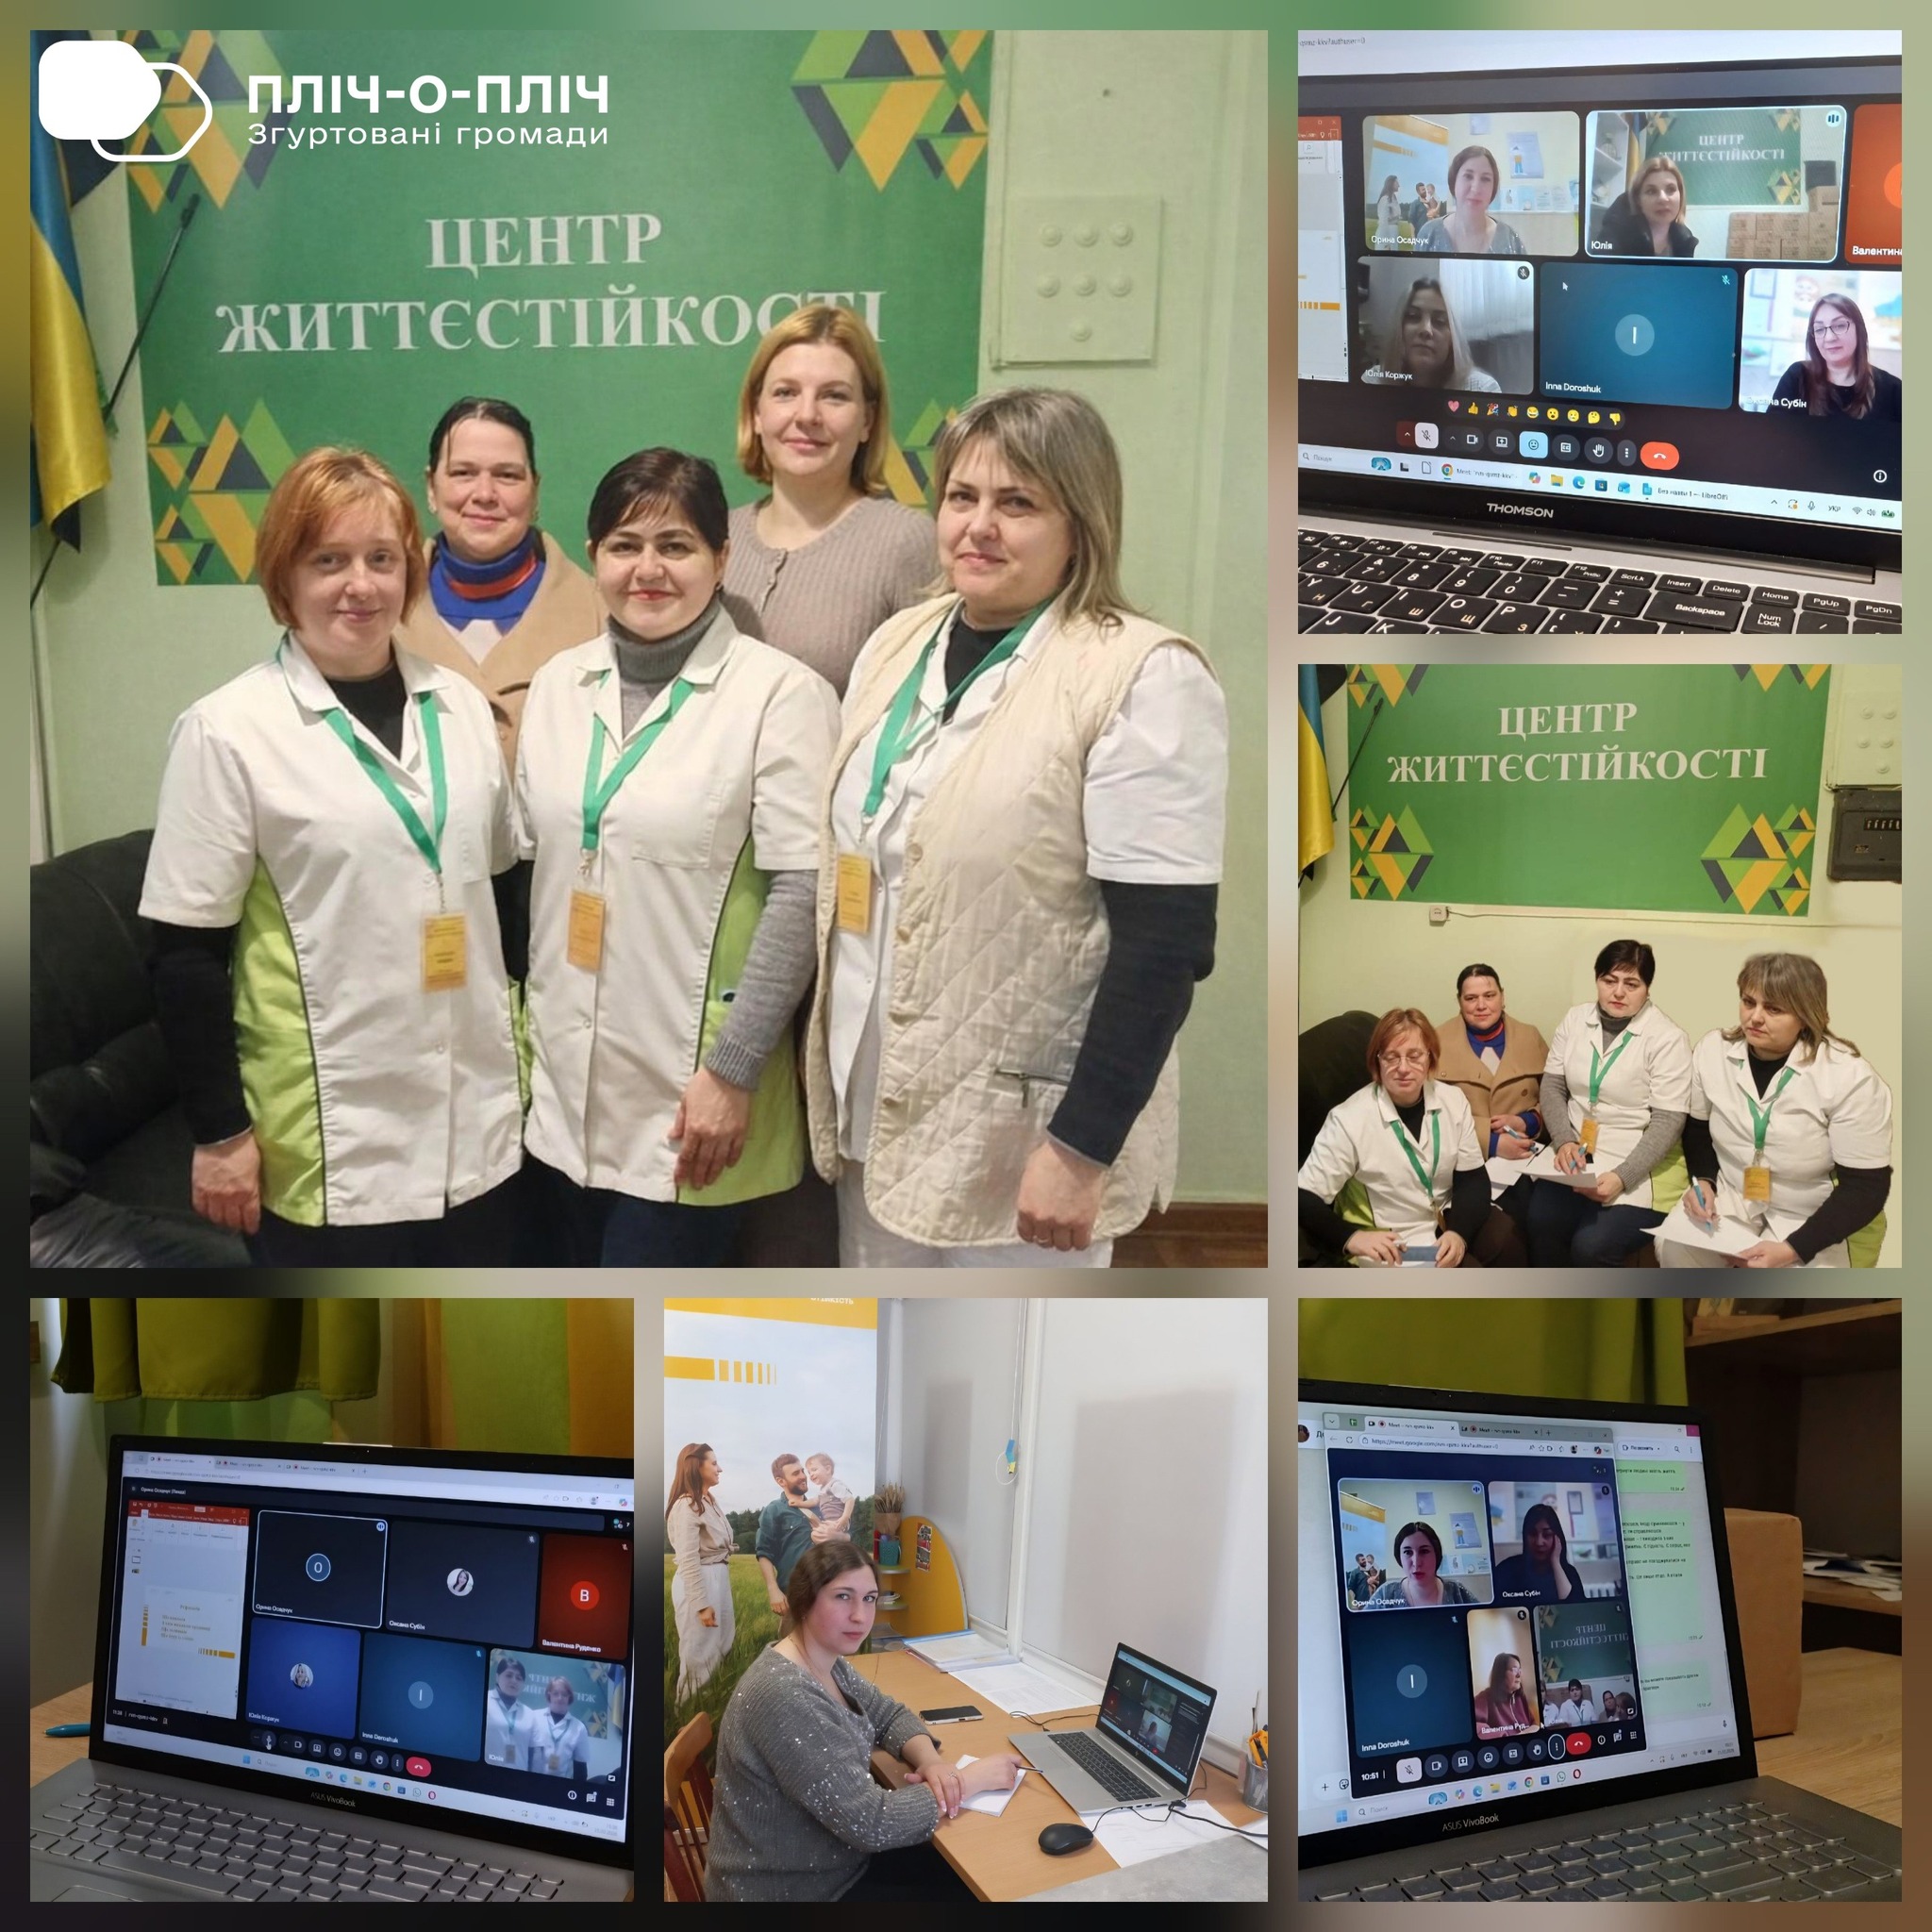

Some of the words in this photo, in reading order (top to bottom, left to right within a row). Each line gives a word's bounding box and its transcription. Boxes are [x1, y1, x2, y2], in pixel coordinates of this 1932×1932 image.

[1698, 134, 1744, 147] ЦЕНТР
[425, 212, 662, 278] ЦЕНТР
[1591, 241, 1613, 250] Юлія
[216, 283, 887, 353] ЖИТТЄСТІЙКОСІ
[1545, 381, 1562, 391] Inna
[1563, 382, 1602, 394] Doroshuk
[1780, 398, 1807, 408] Субін
[1486, 503, 1555, 518] THOMSON
[1307, 578, 1323, 587] Y
[1621, 574, 1644, 582] ScrLk
[1667, 579, 1691, 588] Insert
[1352, 585, 1368, 594] U
[1712, 585, 1740, 594] Delete
[1762, 591, 1790, 601] Home
[1813, 597, 1840, 608] PgUp
[1500, 606, 1516, 615] P
[1674, 604, 1725, 616] Backspace
[1865, 605, 1892, 615] PgDn
[1325, 615, 1341, 625] J
[1758, 613, 1782, 622] Num
[1376, 623, 1394, 633] K
[1757, 619, 1781, 628] Lock
[1497, 702, 1638, 741] ЦЕНТР
[1387, 744, 1771, 783] ЖИТТЄСТІЙКОСТІ
[1361, 1743, 1377, 1752] Inna
[1377, 1739, 1410, 1750] Doroshuk
[1361, 1772, 1379, 1781] 10:51
[326, 1794, 356, 1807] VivoBook
[1442, 1821, 1462, 1832] ASUS
[1462, 1813, 1500, 1828] VivoBook
